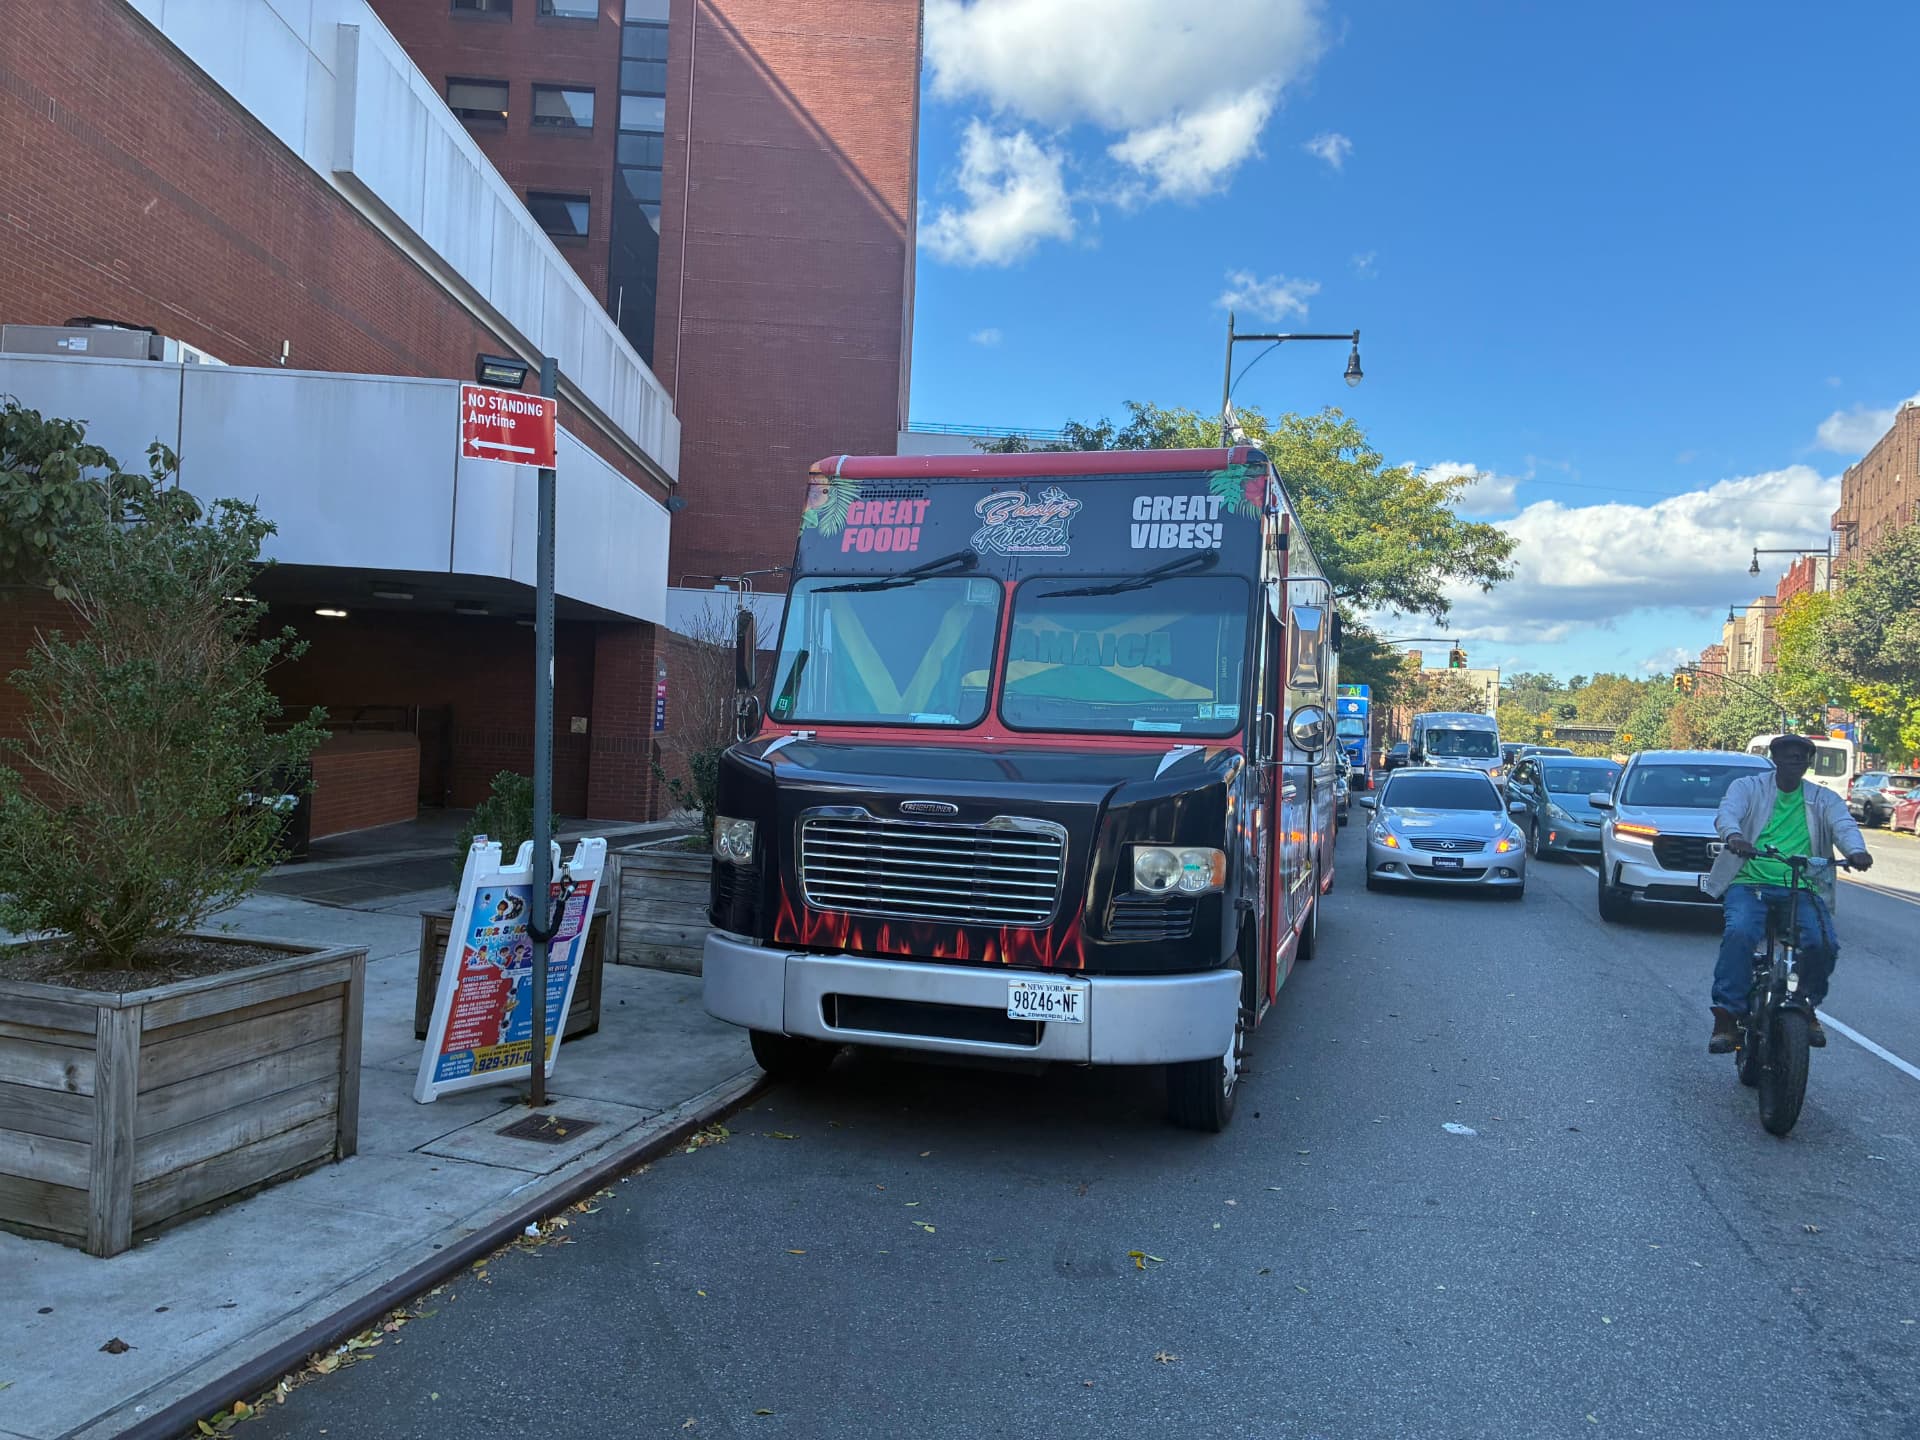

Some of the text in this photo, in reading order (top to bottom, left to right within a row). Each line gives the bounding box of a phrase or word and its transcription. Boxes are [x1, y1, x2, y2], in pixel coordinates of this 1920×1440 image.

[468, 393, 543, 416] NO STANDING
[469, 410, 516, 429] Anytime
[847, 499, 931, 525] GREAT
[1132, 495, 1225, 520] GREAT
[841, 527, 920, 552] FOOD!
[972, 523, 1063, 552] Kitchen
[1131, 522, 1224, 548] VIBES!
[1009, 628, 1172, 667] AMAICA
[502, 924, 528, 935] SPAC
[1027, 984, 1065, 997] NEW YORK
